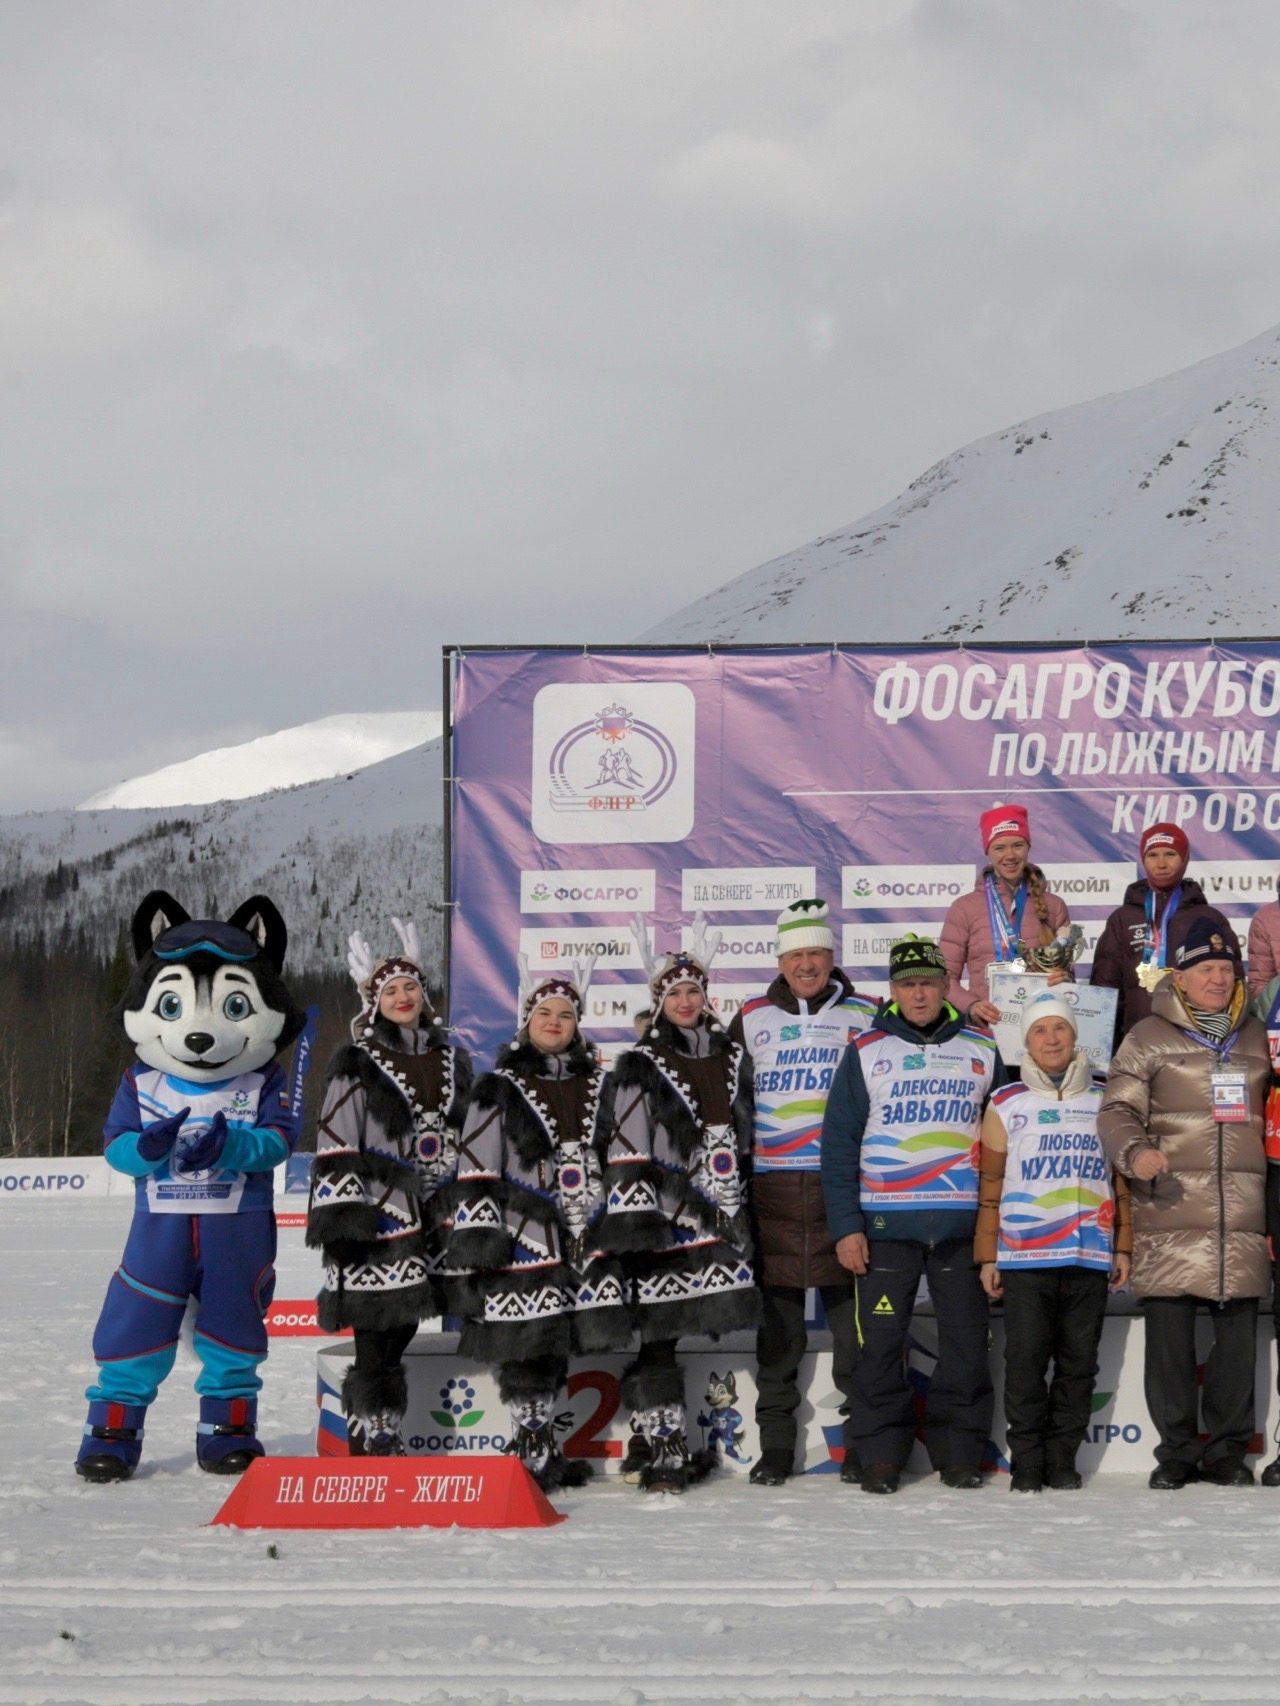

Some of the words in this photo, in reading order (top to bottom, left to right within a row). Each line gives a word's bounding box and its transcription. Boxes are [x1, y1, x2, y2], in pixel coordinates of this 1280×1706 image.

[872, 661, 1131, 725] ФОСАГРО
[988, 733, 1046, 777] ПО
[1052, 730, 1264, 776] ЛЫЖНЫМ
[693, 885, 709, 901] НА
[711, 884, 753, 901] СЕВЕРЕ
[764, 883, 803, 900] ЖИТЬ!
[877, 882, 961, 896] ФОСАГРО
[1187, 876, 1273, 892] IVIUM
[554, 887, 639, 901] ФОСАГРО
[561, 939, 631, 957] ЛУКОЙЛ
[854, 939, 869, 954] НА
[776, 1048, 840, 1066] МИХАИЛ
[890, 1079, 976, 1099] АЛЕКСАНДР
[881, 1100, 978, 1126] ЗАВЬЯЛОВ
[1038, 1133, 1099, 1152] ЛЮБОВЬ
[0, 1174, 85, 1191] ОСАГРО
[172, 1192, 217, 1200] ТИРВАС
[562, 1370, 624, 1459] 2
[409, 1434, 506, 1452] ФОСАГРО
[276, 1476, 305, 1503] НА
[312, 1476, 388, 1503] СЕВЕРЕ
[411, 1475, 485, 1503] ЖИТЬ!
